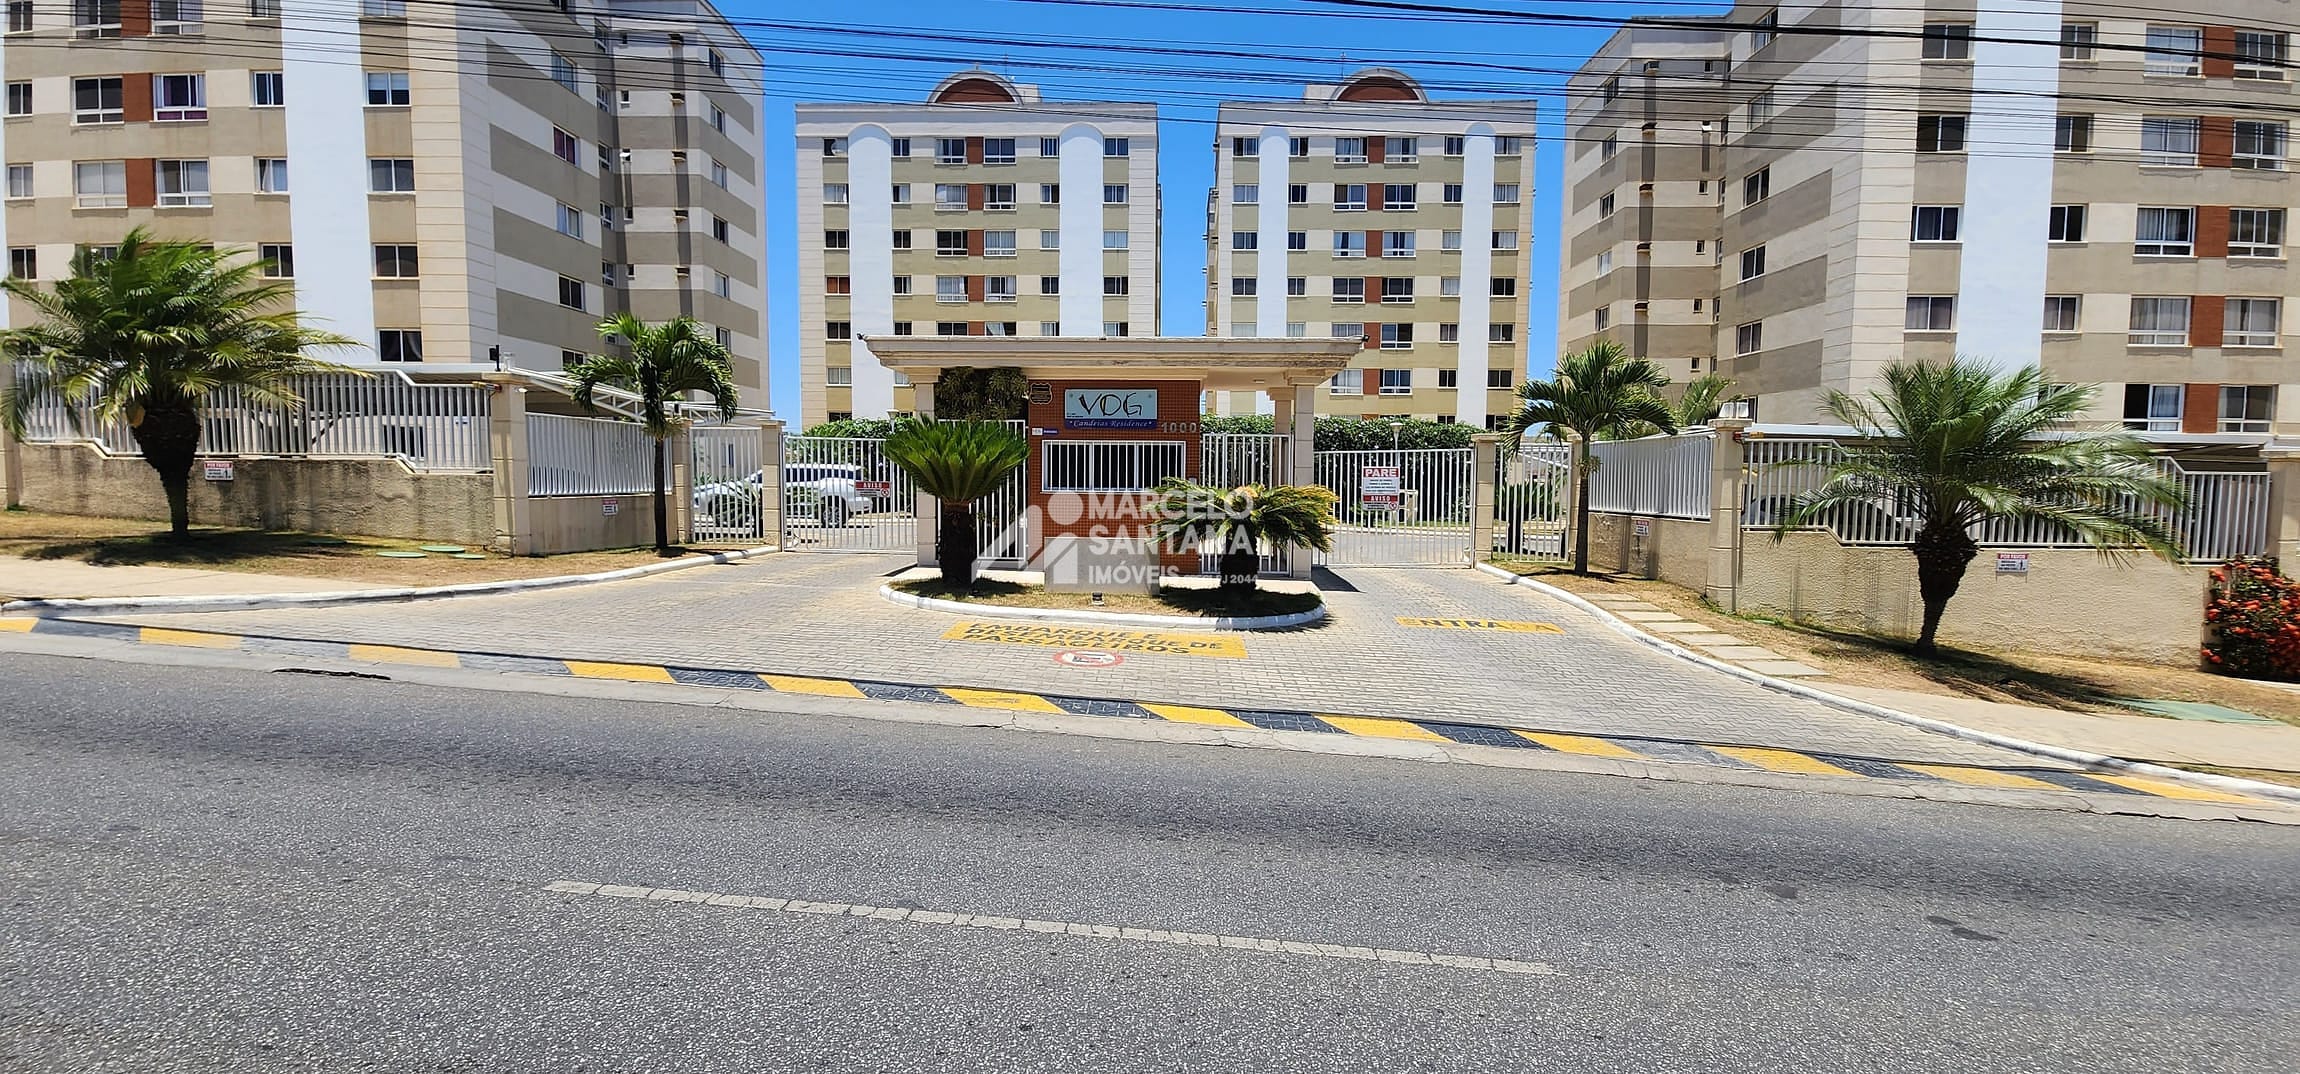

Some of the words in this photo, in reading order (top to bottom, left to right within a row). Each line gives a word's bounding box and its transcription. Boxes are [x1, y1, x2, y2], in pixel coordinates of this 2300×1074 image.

[1078, 392, 1142, 418] VOG
[1161, 422, 1197, 433] 1000
[1365, 468, 1397, 477] PARE
[969, 622, 1135, 639] EMBARQUE
[962, 634, 1190, 654] PASSAGEIROS
[1190, 641, 1223, 650] DE
